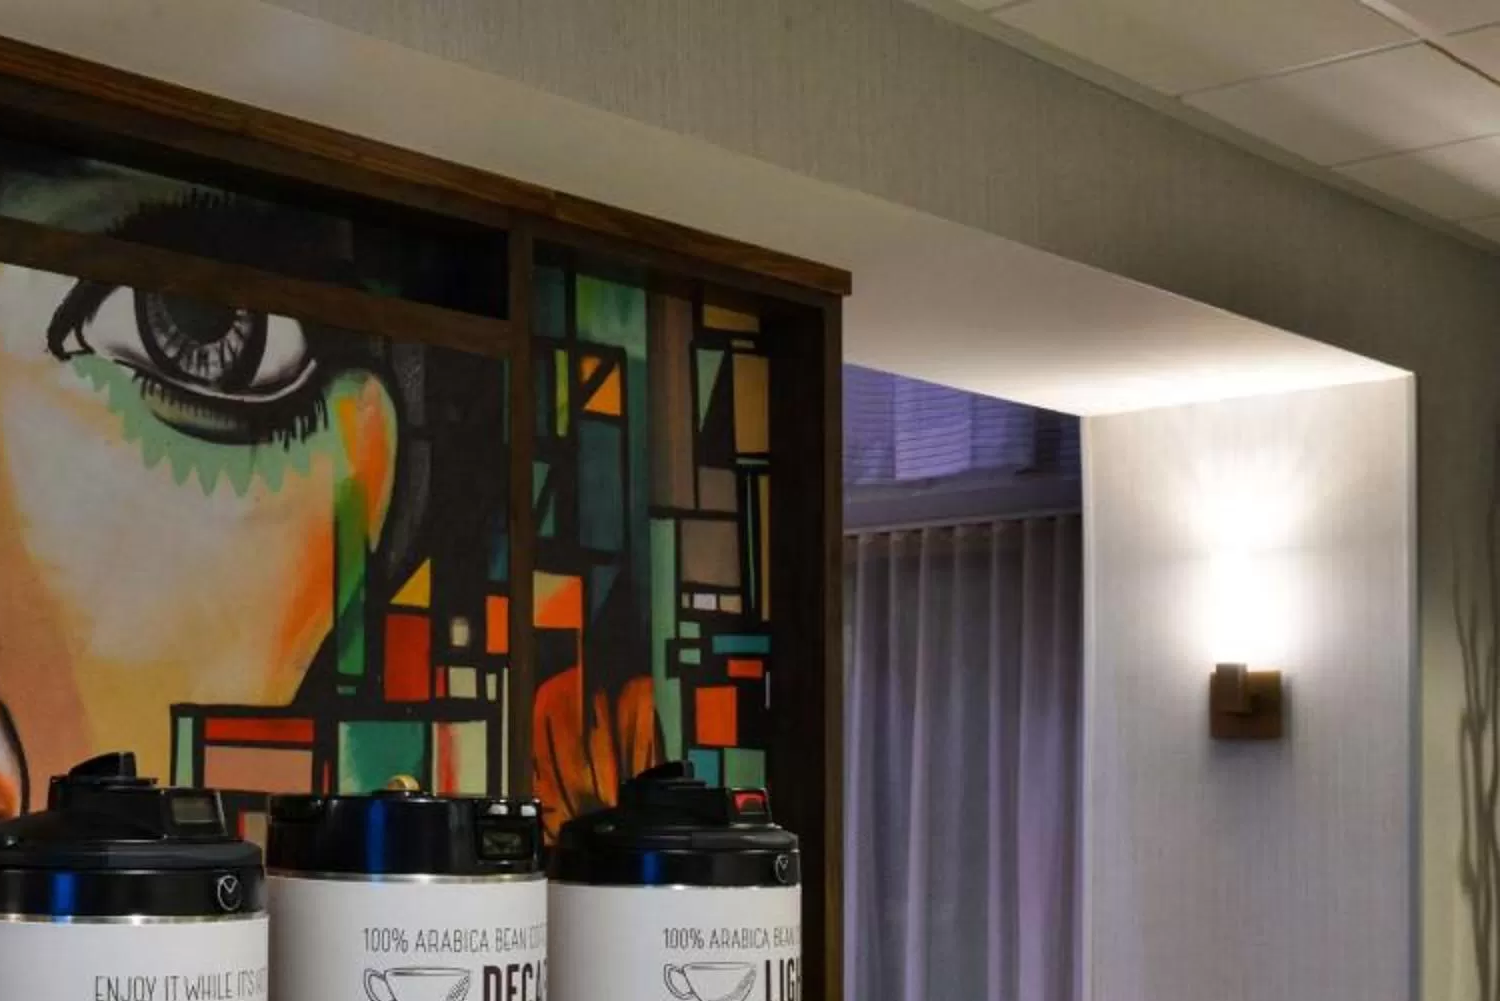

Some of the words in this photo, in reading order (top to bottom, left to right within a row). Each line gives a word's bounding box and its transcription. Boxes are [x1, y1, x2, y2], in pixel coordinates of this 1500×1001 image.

[363, 927, 409, 953] 100%
[415, 928, 490, 953] ARABICA
[495, 927, 527, 953] BEAN
[663, 927, 705, 949] 100%
[709, 927, 770, 949] ARABICA
[184, 972, 233, 1001] WHILE
